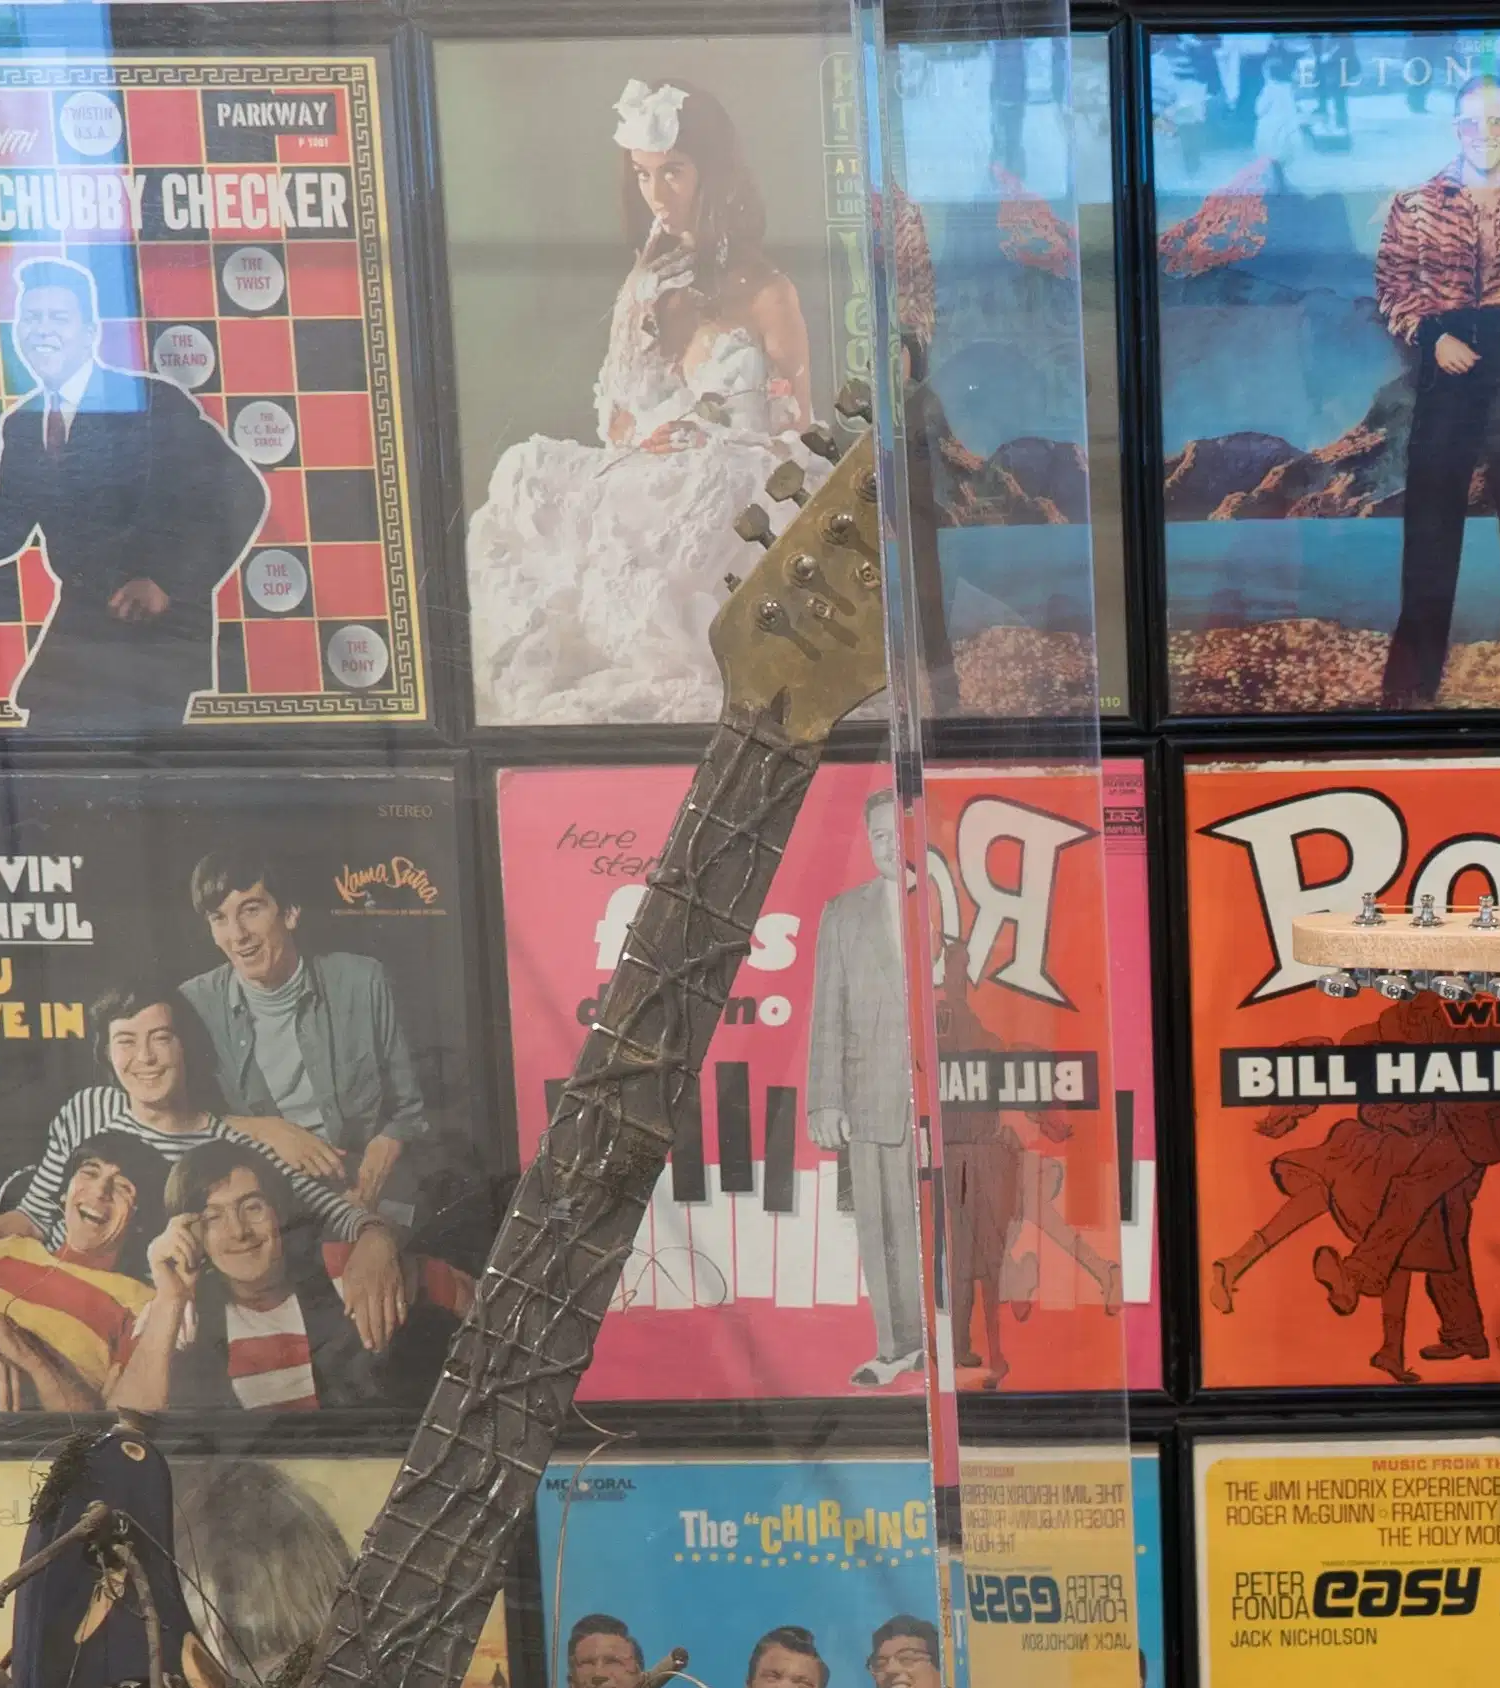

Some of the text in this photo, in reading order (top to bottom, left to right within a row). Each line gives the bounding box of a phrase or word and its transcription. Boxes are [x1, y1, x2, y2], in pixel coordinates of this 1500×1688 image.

[1298, 54, 1475, 88] ELTON
[217, 99, 327, 129] PARKWAY
[163, 171, 349, 230] CHECKER
[171, 333, 194, 348] THE
[159, 352, 208, 367] STRAND
[39, 1002, 85, 1039] IN
[1237, 1053, 1357, 1098] BILL
[1235, 1571, 1305, 1597] PETER
[1312, 1565, 1482, 1618] easy
[1231, 1595, 1311, 1620] FONDA
[1230, 1626, 1378, 1647] JACK NICHOLSON
